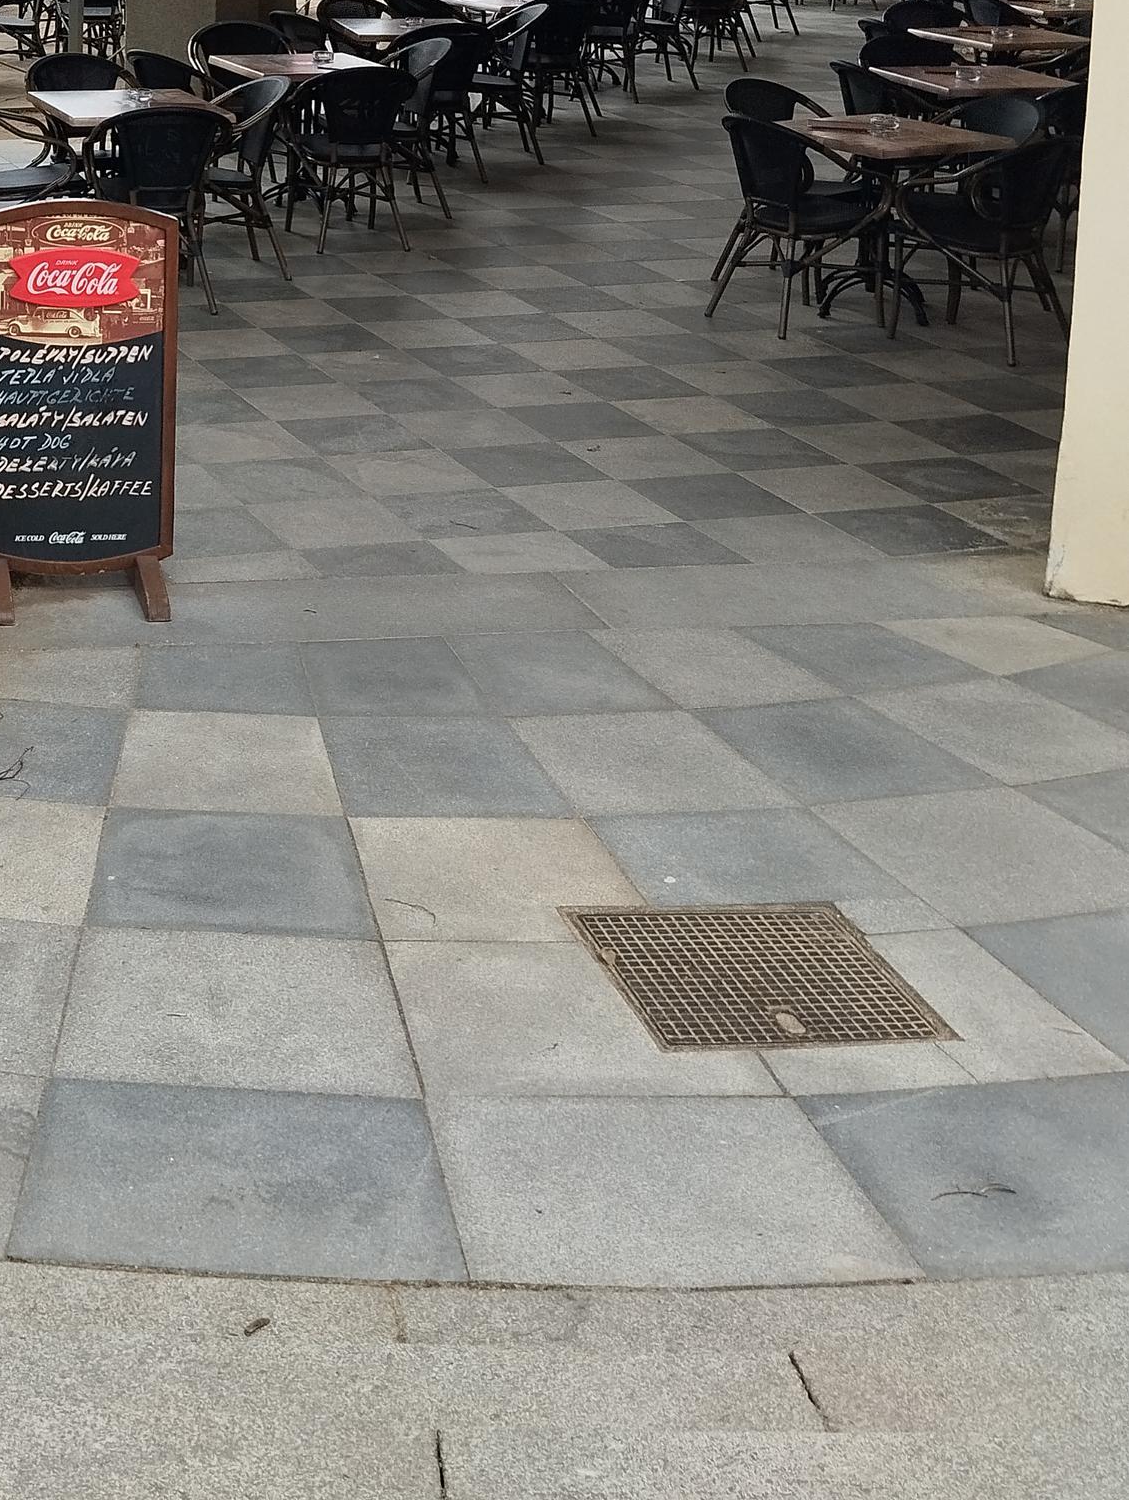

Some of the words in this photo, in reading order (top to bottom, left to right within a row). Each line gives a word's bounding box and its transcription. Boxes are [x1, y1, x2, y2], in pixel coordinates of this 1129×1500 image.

[45, 224, 114, 242] Coca-Cola
[26, 261, 122, 296] Coca-Cola
[37, 433, 72, 451] DOG
[14, 534, 27, 542] ICE
[27, 534, 45, 542] COLD
[90, 533, 108, 541] SOLD
